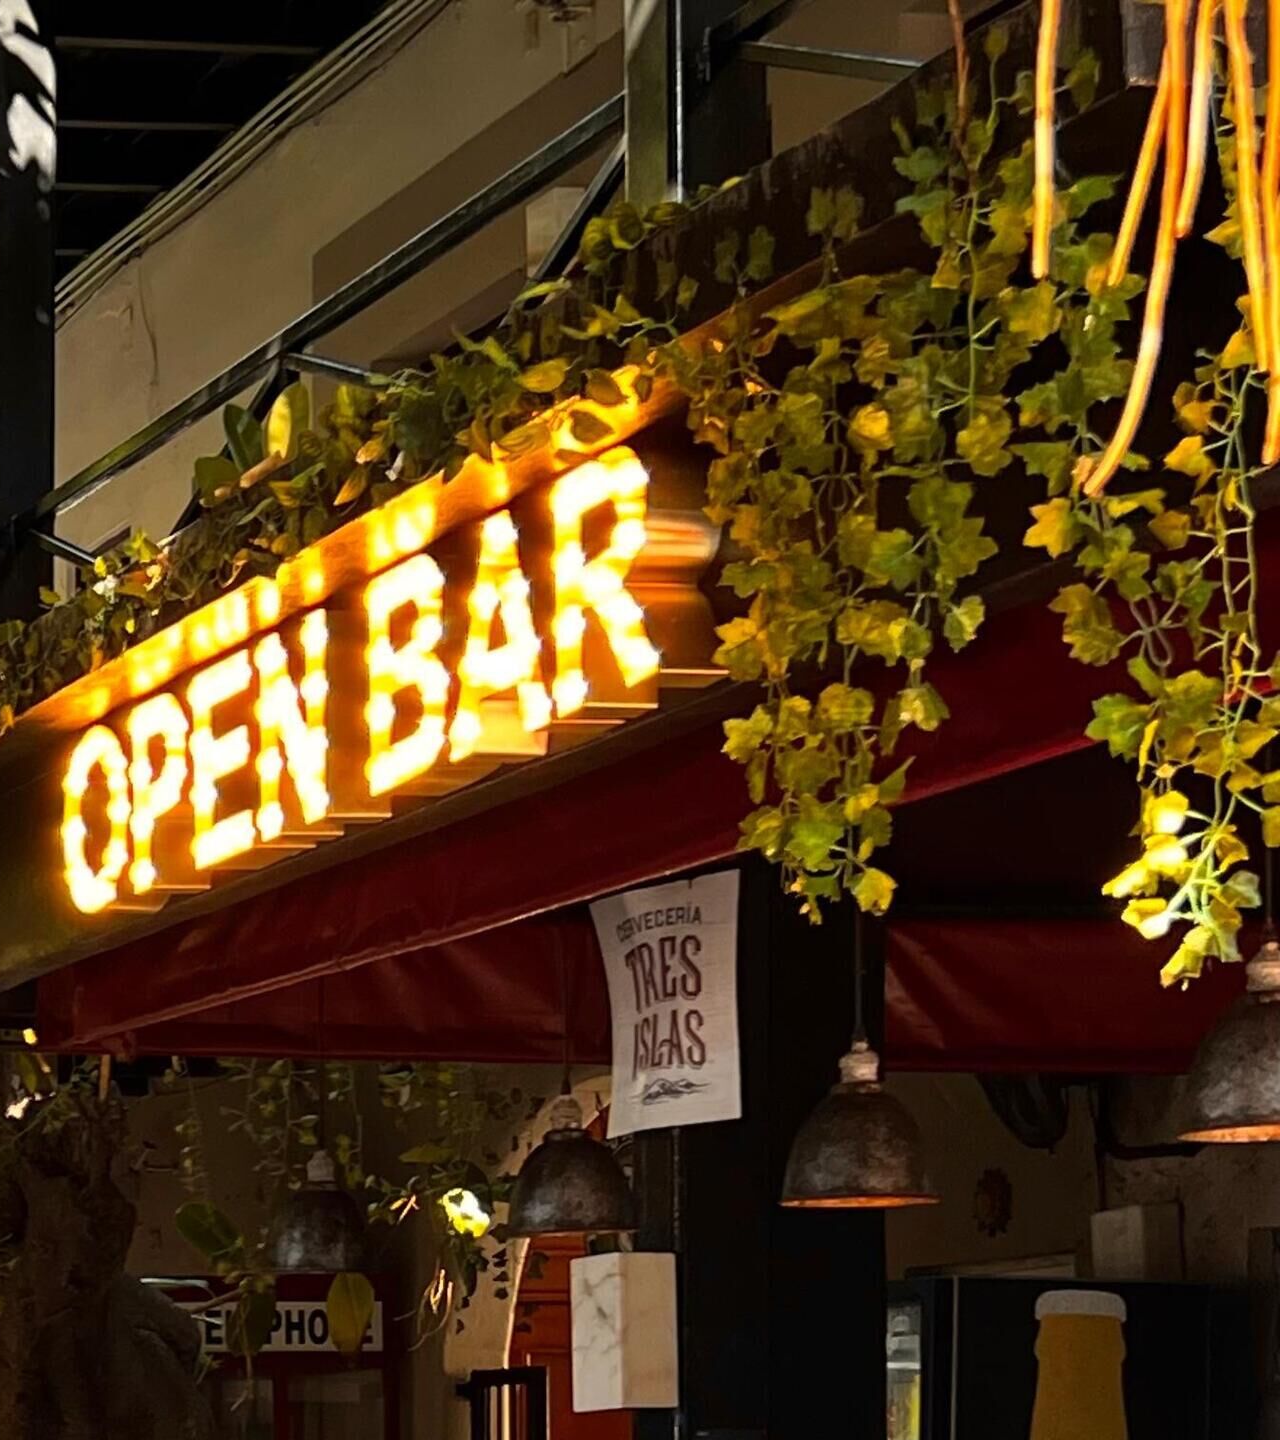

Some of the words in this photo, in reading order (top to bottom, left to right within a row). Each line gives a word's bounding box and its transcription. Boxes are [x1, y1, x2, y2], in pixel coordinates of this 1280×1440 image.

[61, 606, 331, 914] OPEN
[362, 446, 661, 797] BAR
[624, 935, 703, 1014] TRES
[632, 1009, 707, 1081] ISLAS
